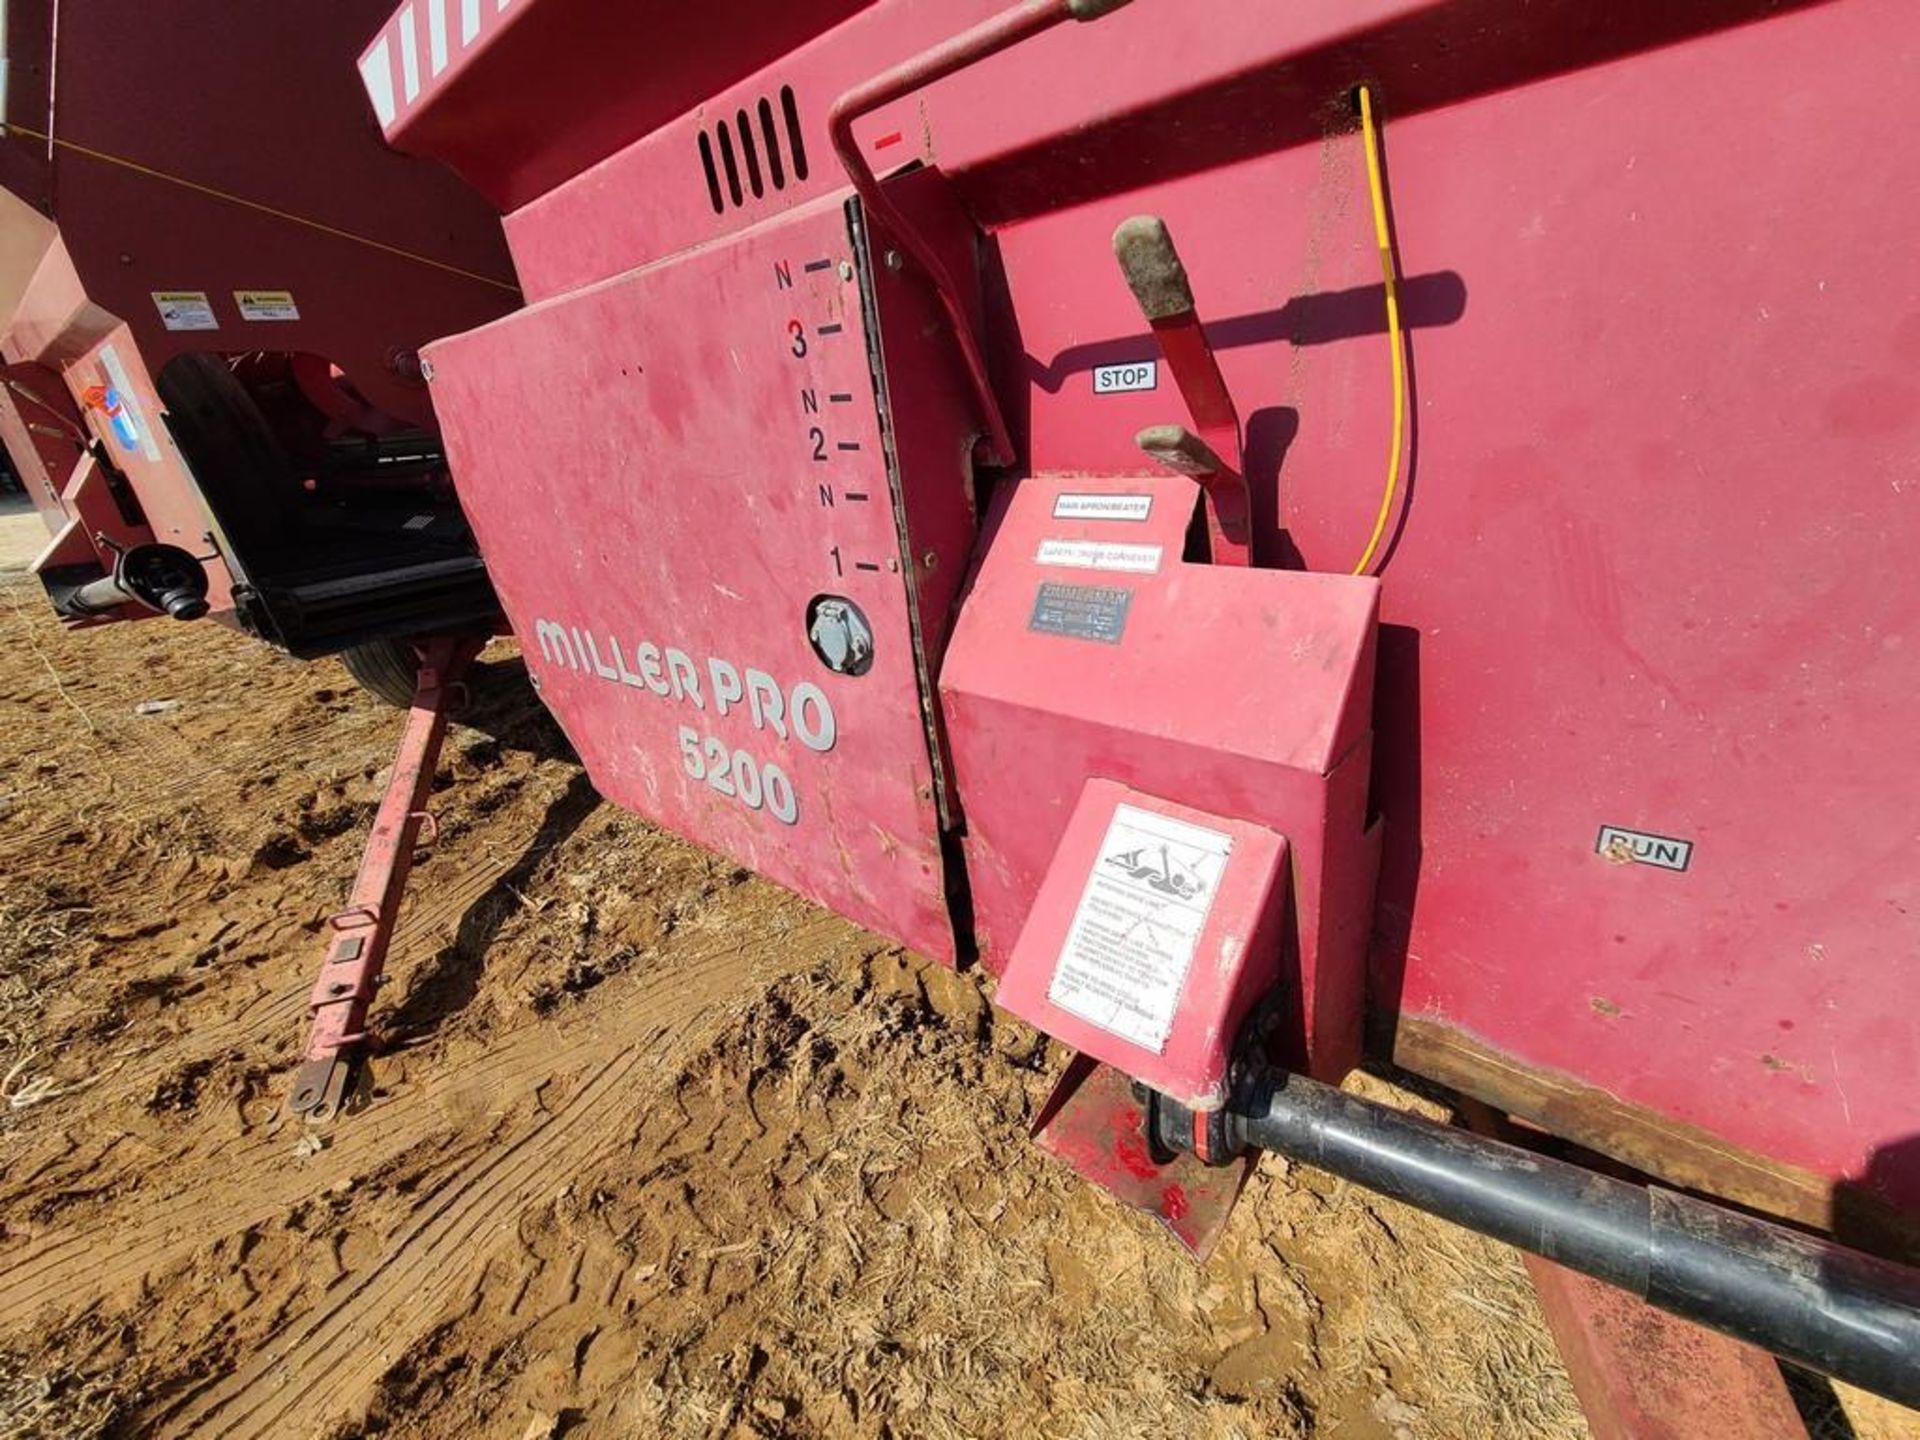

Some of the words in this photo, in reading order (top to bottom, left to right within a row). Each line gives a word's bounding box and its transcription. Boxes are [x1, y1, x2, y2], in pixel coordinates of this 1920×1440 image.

[774, 259, 792, 290] N
[788, 320, 807, 358] 3
[1101, 368, 1148, 387] STOP
[801, 388, 818, 414] N
[809, 426, 828, 461] 2
[819, 484, 834, 507] N
[830, 546, 842, 577] 1
[535, 617, 705, 710] MILLER
[707, 657, 838, 752] PRO
[678, 724, 798, 826] 5200
